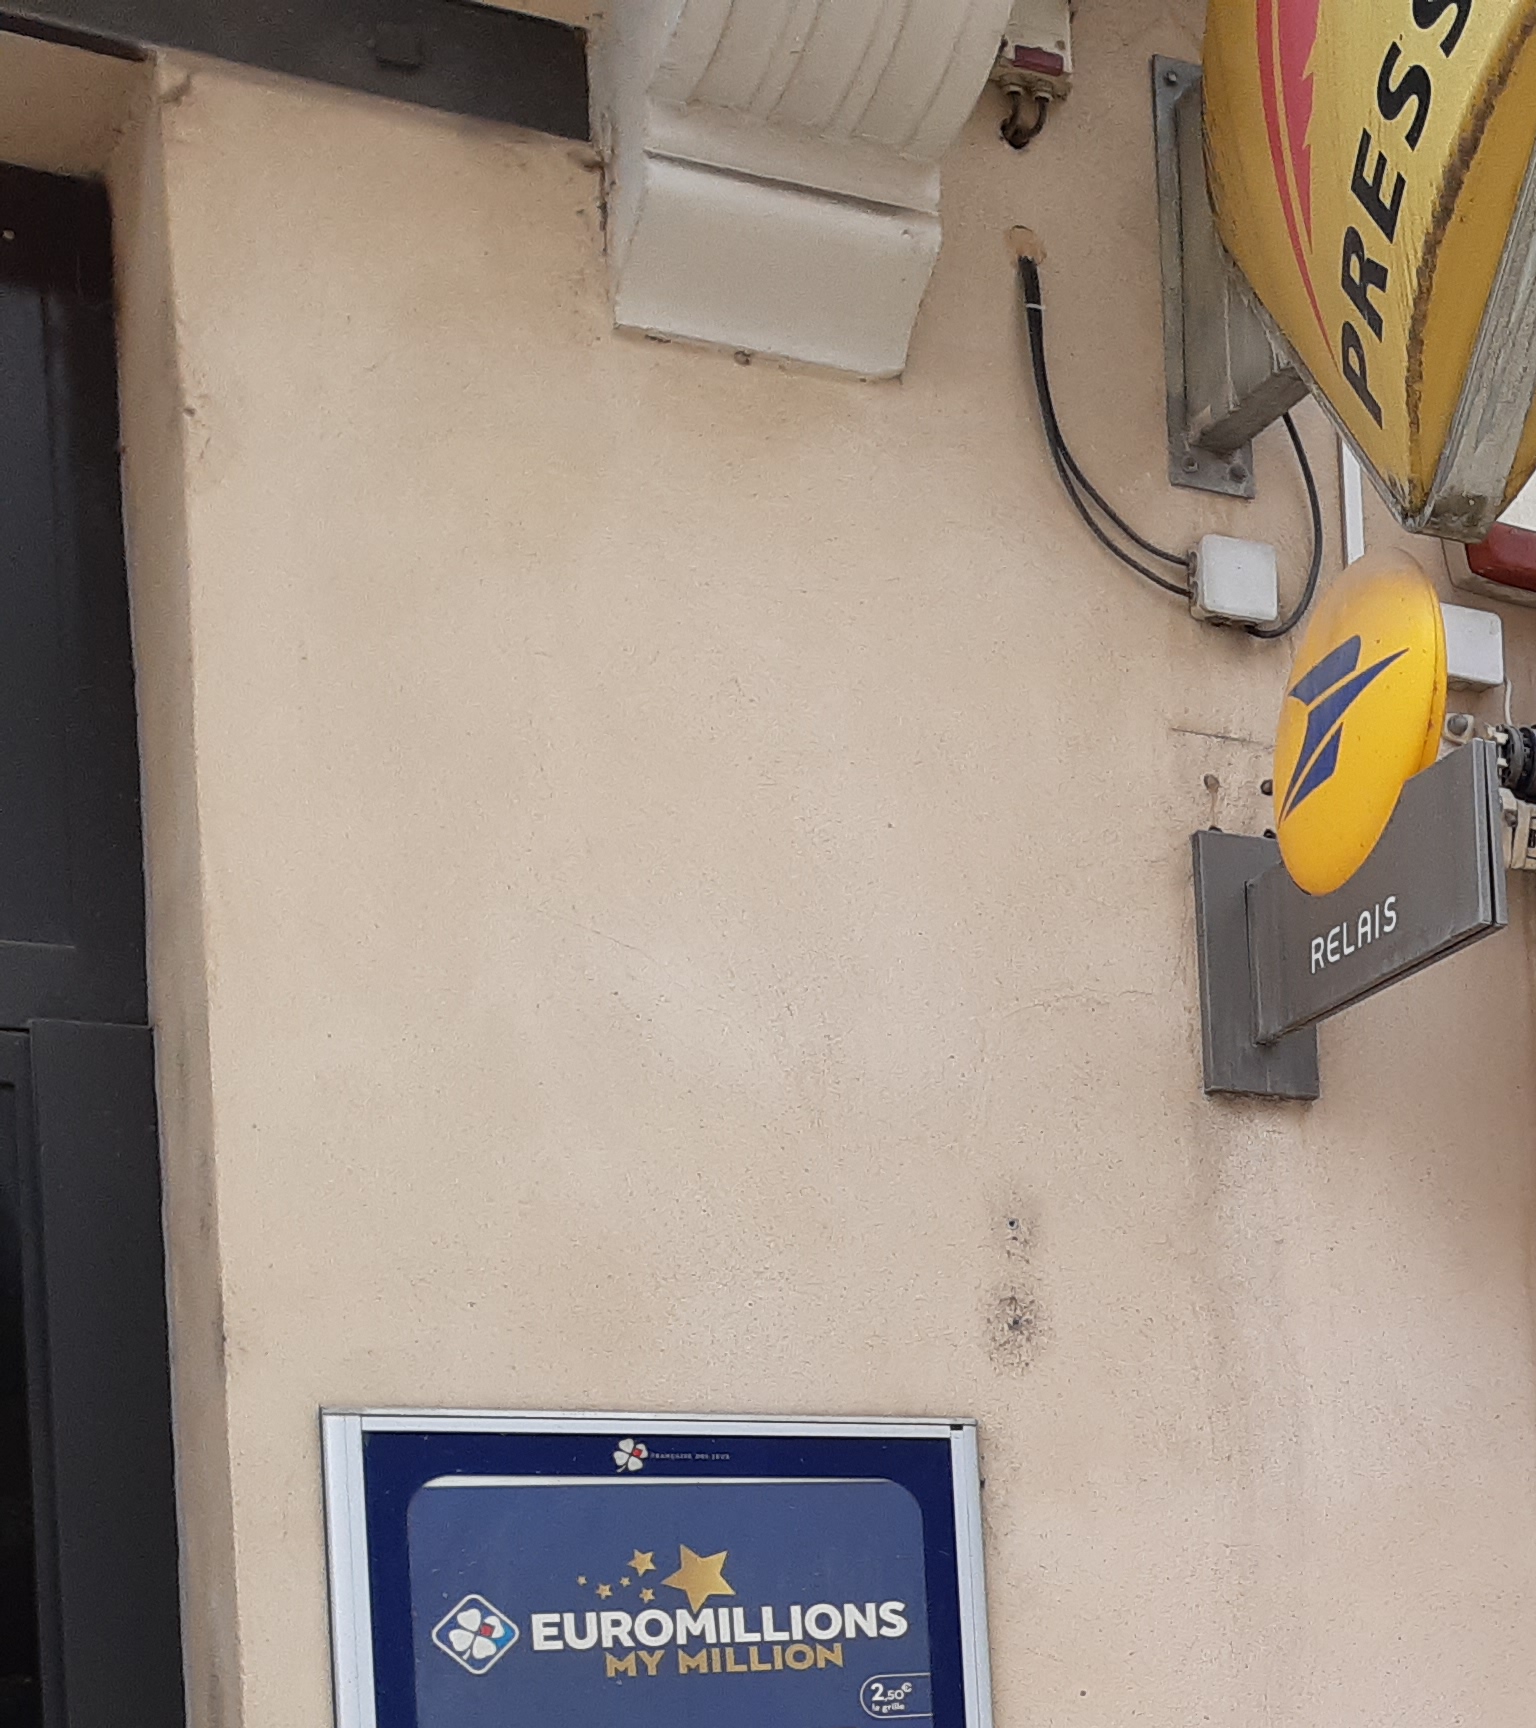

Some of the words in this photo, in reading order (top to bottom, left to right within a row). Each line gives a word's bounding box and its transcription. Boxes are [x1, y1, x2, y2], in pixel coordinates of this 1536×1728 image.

[1310, 896, 1398, 975] RELAIS
[531, 1601, 908, 1651] EUROMILLIONS
[606, 1650, 665, 1678] MY
[678, 1643, 844, 1675] MILLION
